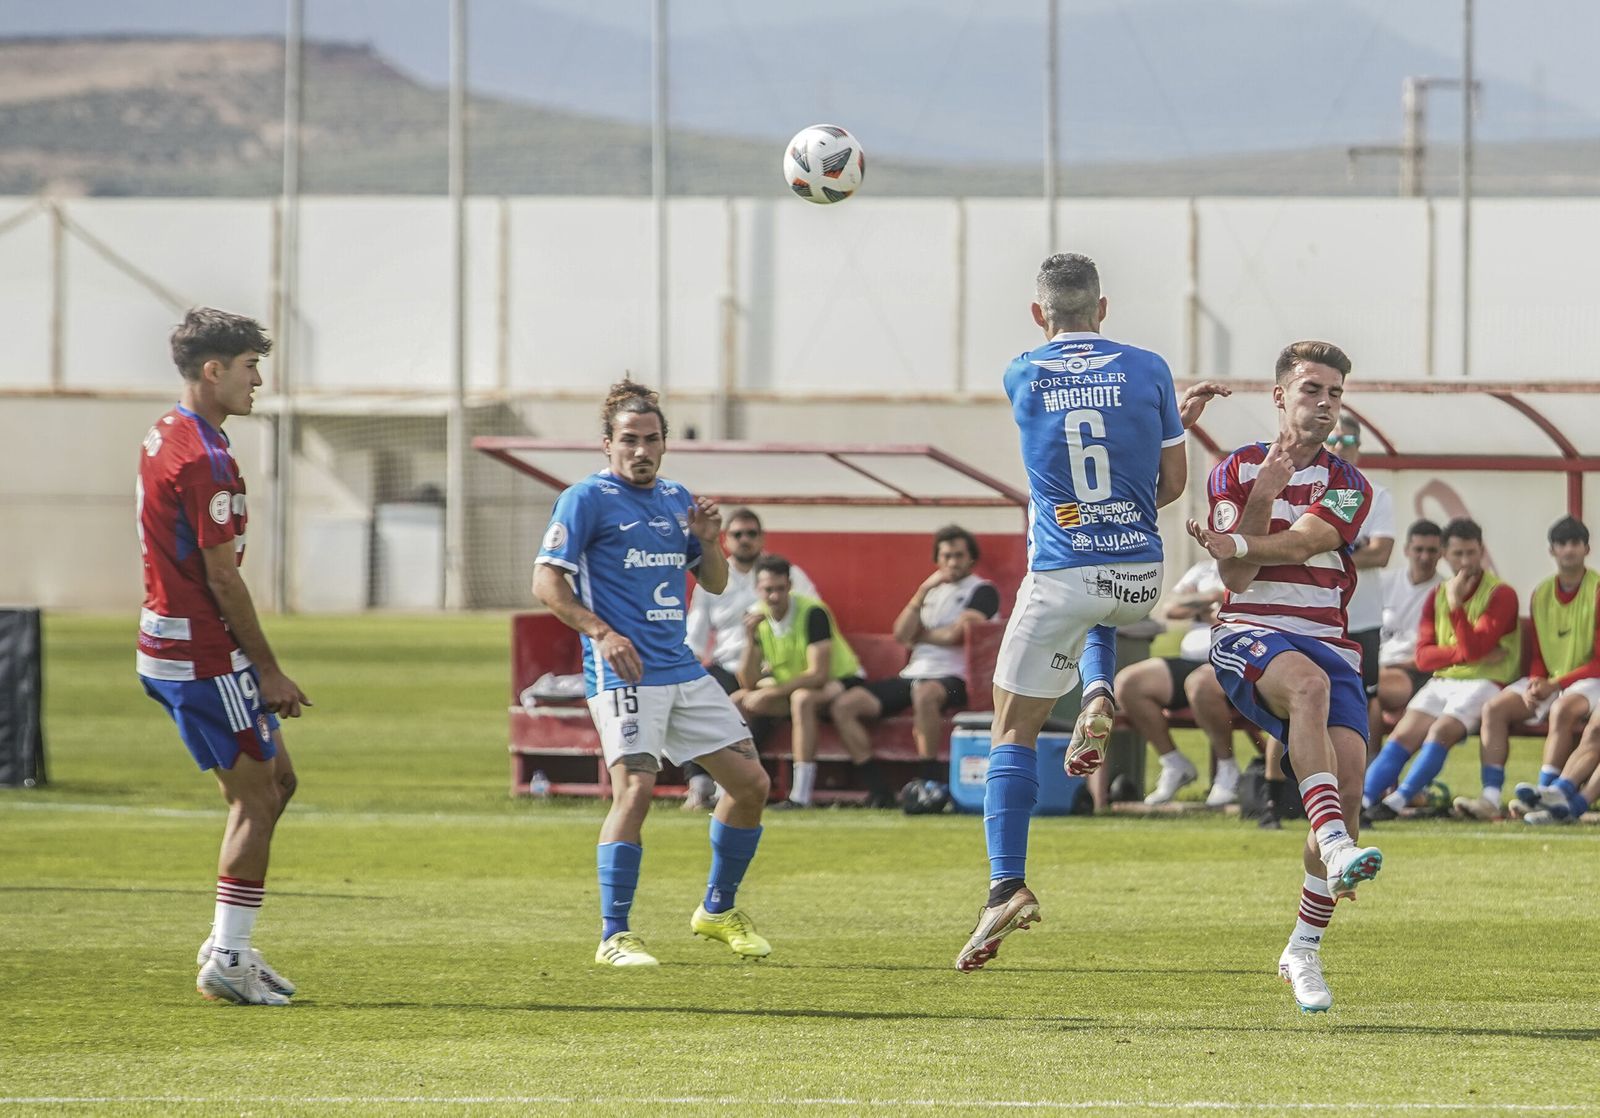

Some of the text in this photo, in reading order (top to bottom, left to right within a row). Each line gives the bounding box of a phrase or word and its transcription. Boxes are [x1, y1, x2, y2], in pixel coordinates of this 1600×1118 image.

[1030, 373, 1127, 391] PORTRAILER
[1043, 386, 1122, 413] MACHOTE
[1064, 409, 1113, 503] 6
[1081, 513, 1100, 525] DE
[1094, 531, 1148, 550] LUJAMA
[624, 548, 686, 570] Alcamp
[1109, 569, 1157, 581] Pavimentos
[1113, 582, 1158, 604] Utebo
[614, 686, 639, 717] 15
